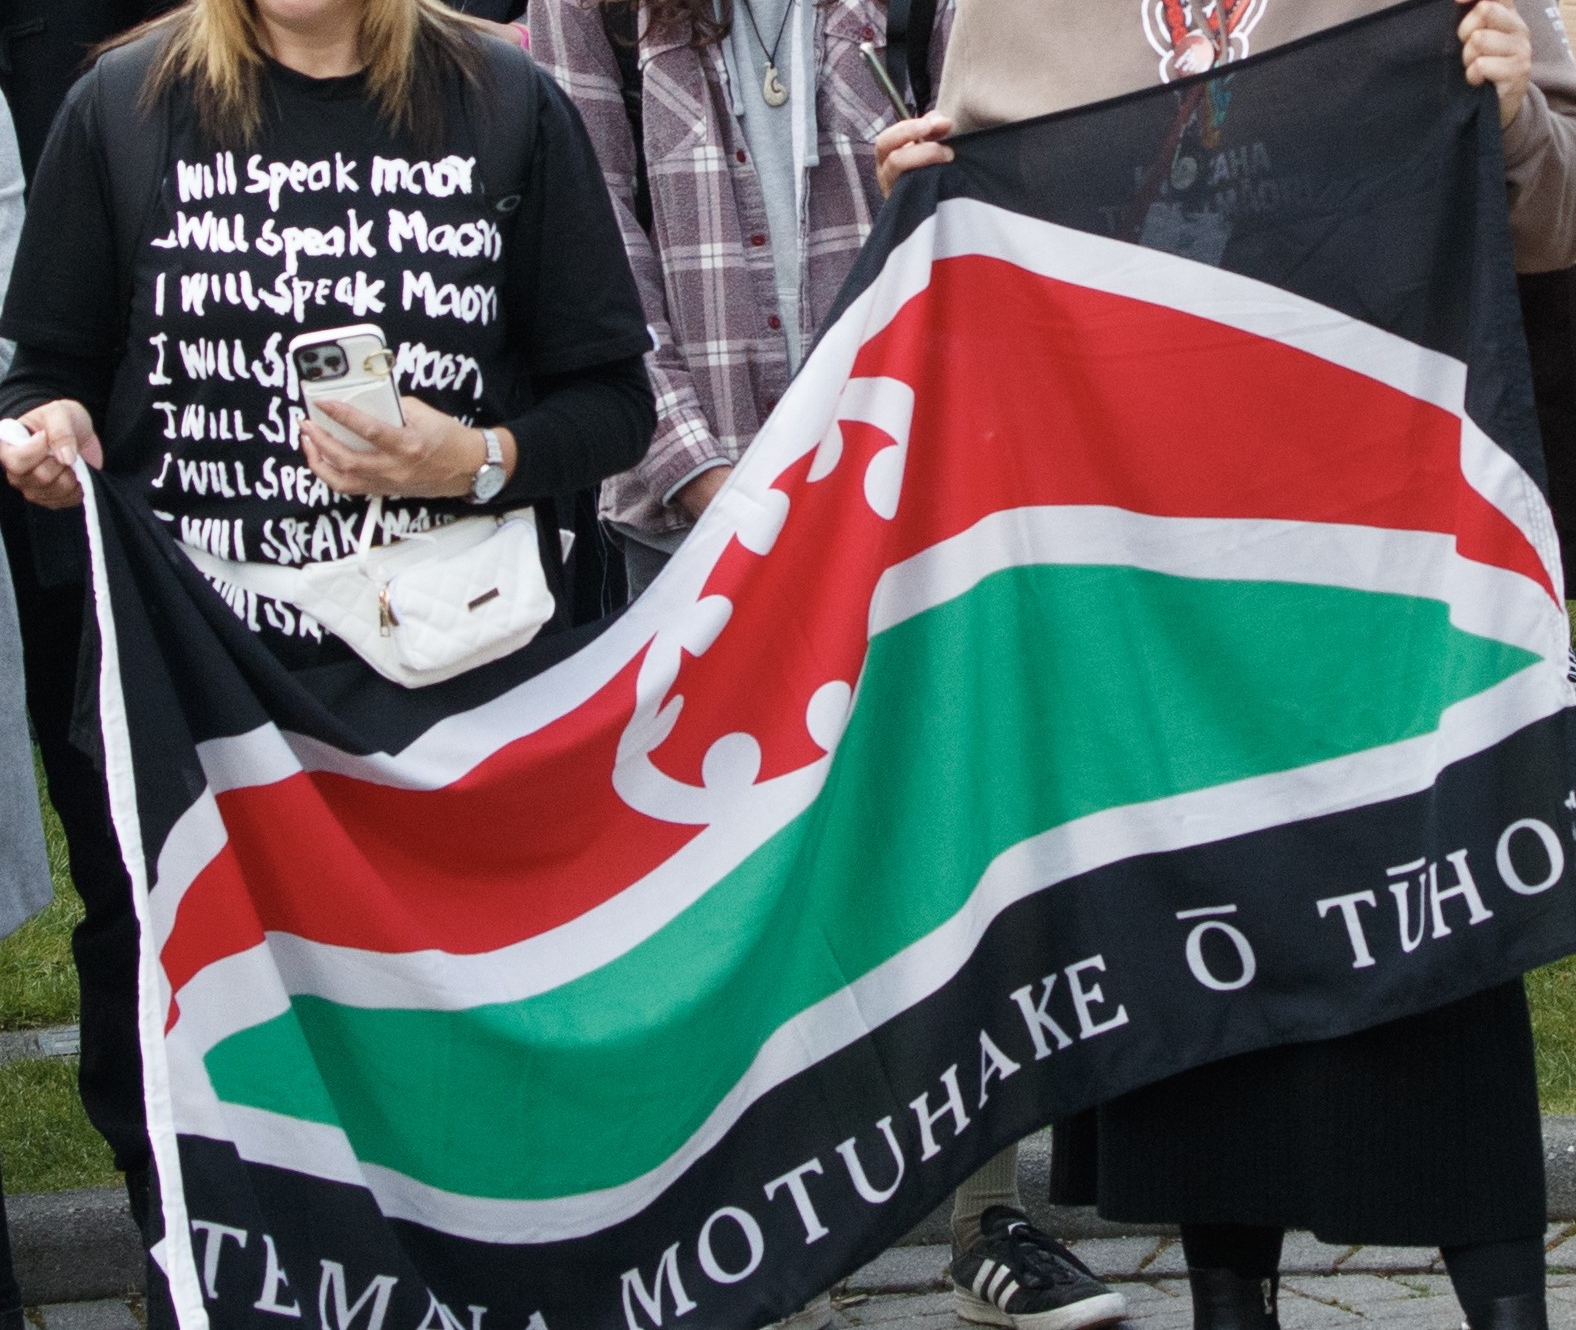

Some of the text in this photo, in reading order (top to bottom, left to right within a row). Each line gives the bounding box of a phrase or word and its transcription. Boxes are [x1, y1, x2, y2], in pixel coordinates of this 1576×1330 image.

[149, 332, 173, 386] I
[152, 401, 177, 441] I
[621, 953, 1129, 1330] MOTUHAKE
[1175, 904, 1257, 992] Ō
